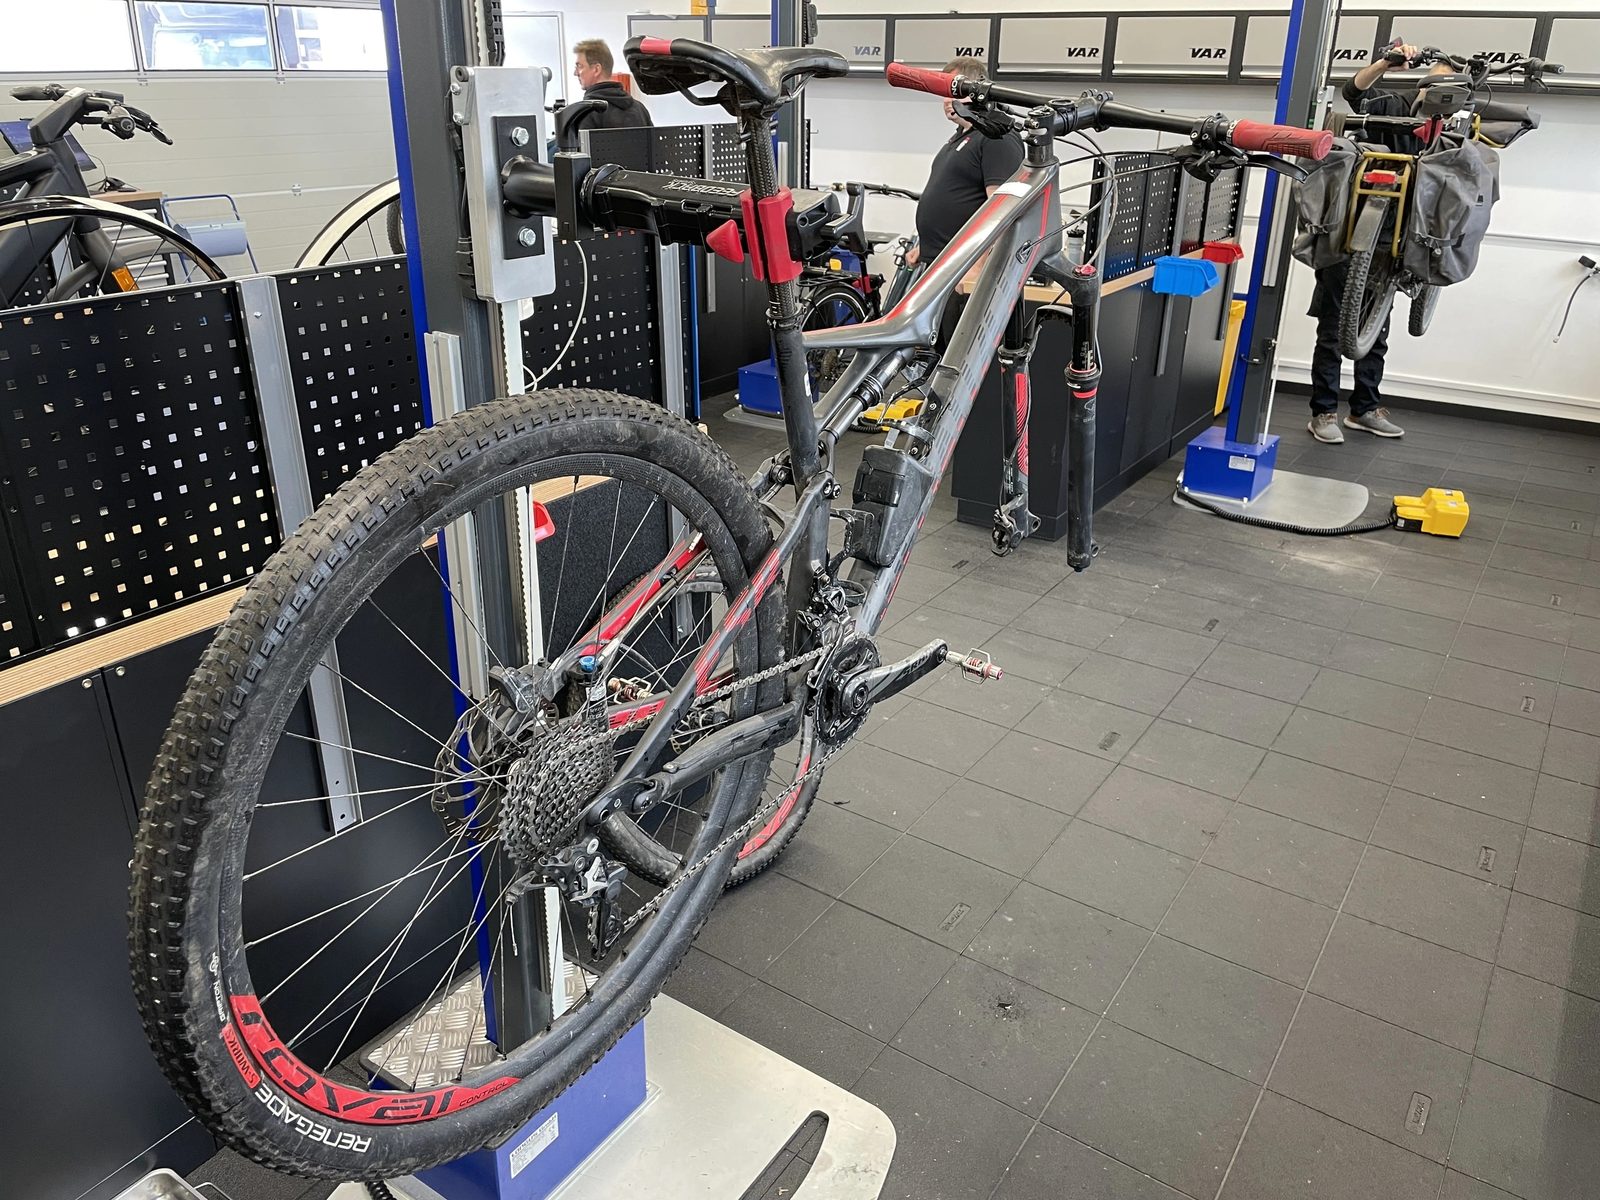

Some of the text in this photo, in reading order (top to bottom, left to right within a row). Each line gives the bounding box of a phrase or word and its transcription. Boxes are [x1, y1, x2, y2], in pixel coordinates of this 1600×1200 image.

[853, 46, 881, 56] VAR
[955, 47, 984, 57] VAR
[1067, 47, 1099, 57] VAR
[1190, 48, 1226, 59] VAR
[224, 1028, 371, 1153] RENEGADE S-WORKS
[458, 1081, 510, 1108] CONTROL
